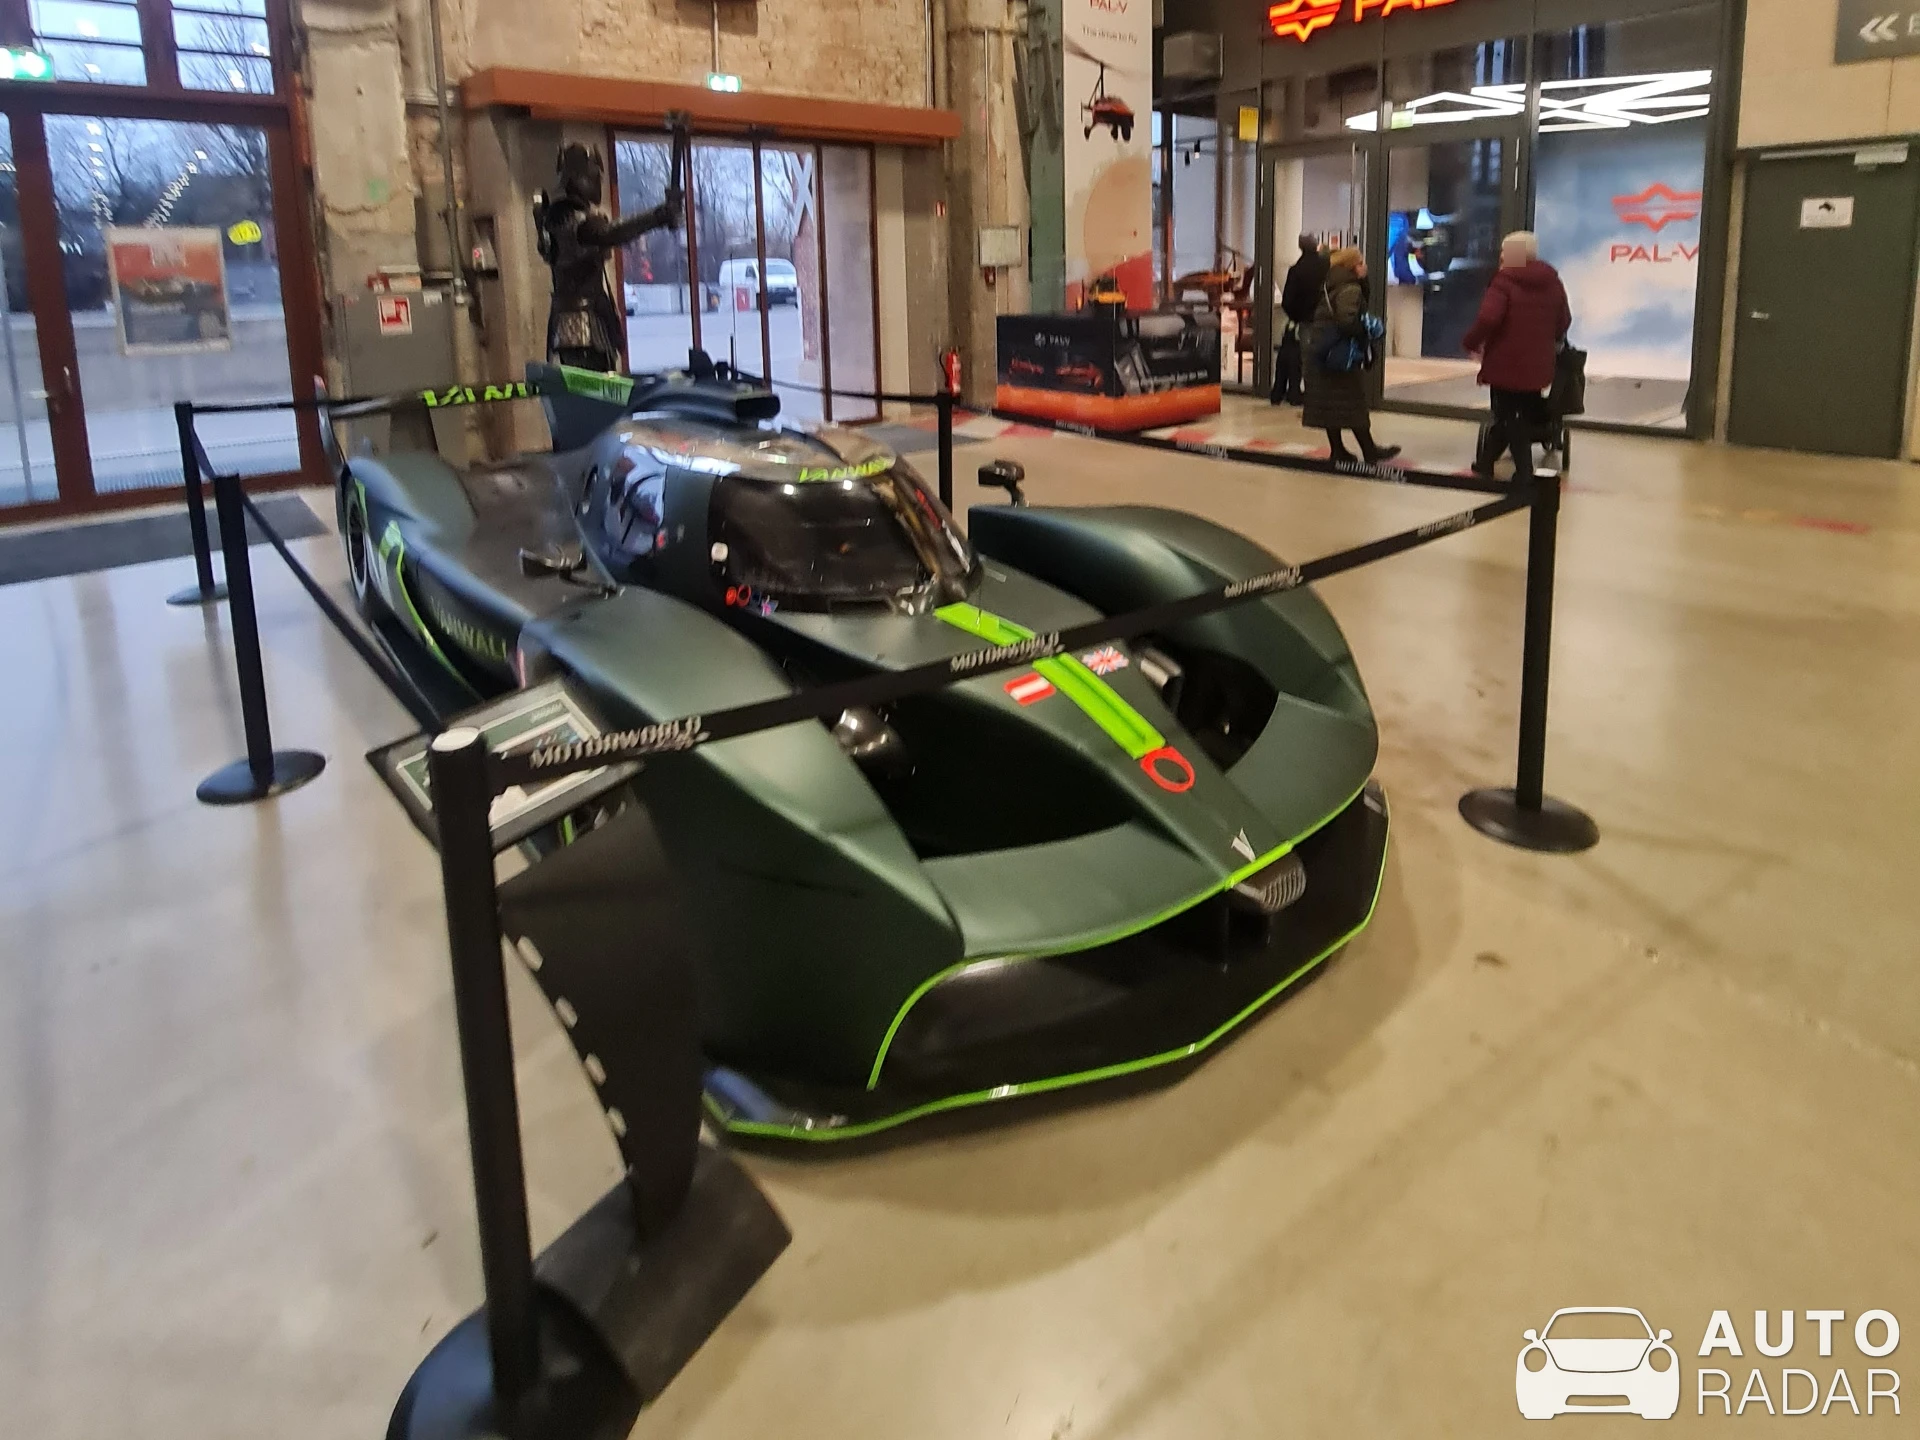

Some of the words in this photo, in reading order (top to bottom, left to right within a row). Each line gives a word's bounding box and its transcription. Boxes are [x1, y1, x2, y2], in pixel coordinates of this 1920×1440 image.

[1610, 243, 1699, 263] PAL-V
[950, 631, 1060, 672] MOTORWORLD
[529, 715, 701, 769] MOTORWORLD
